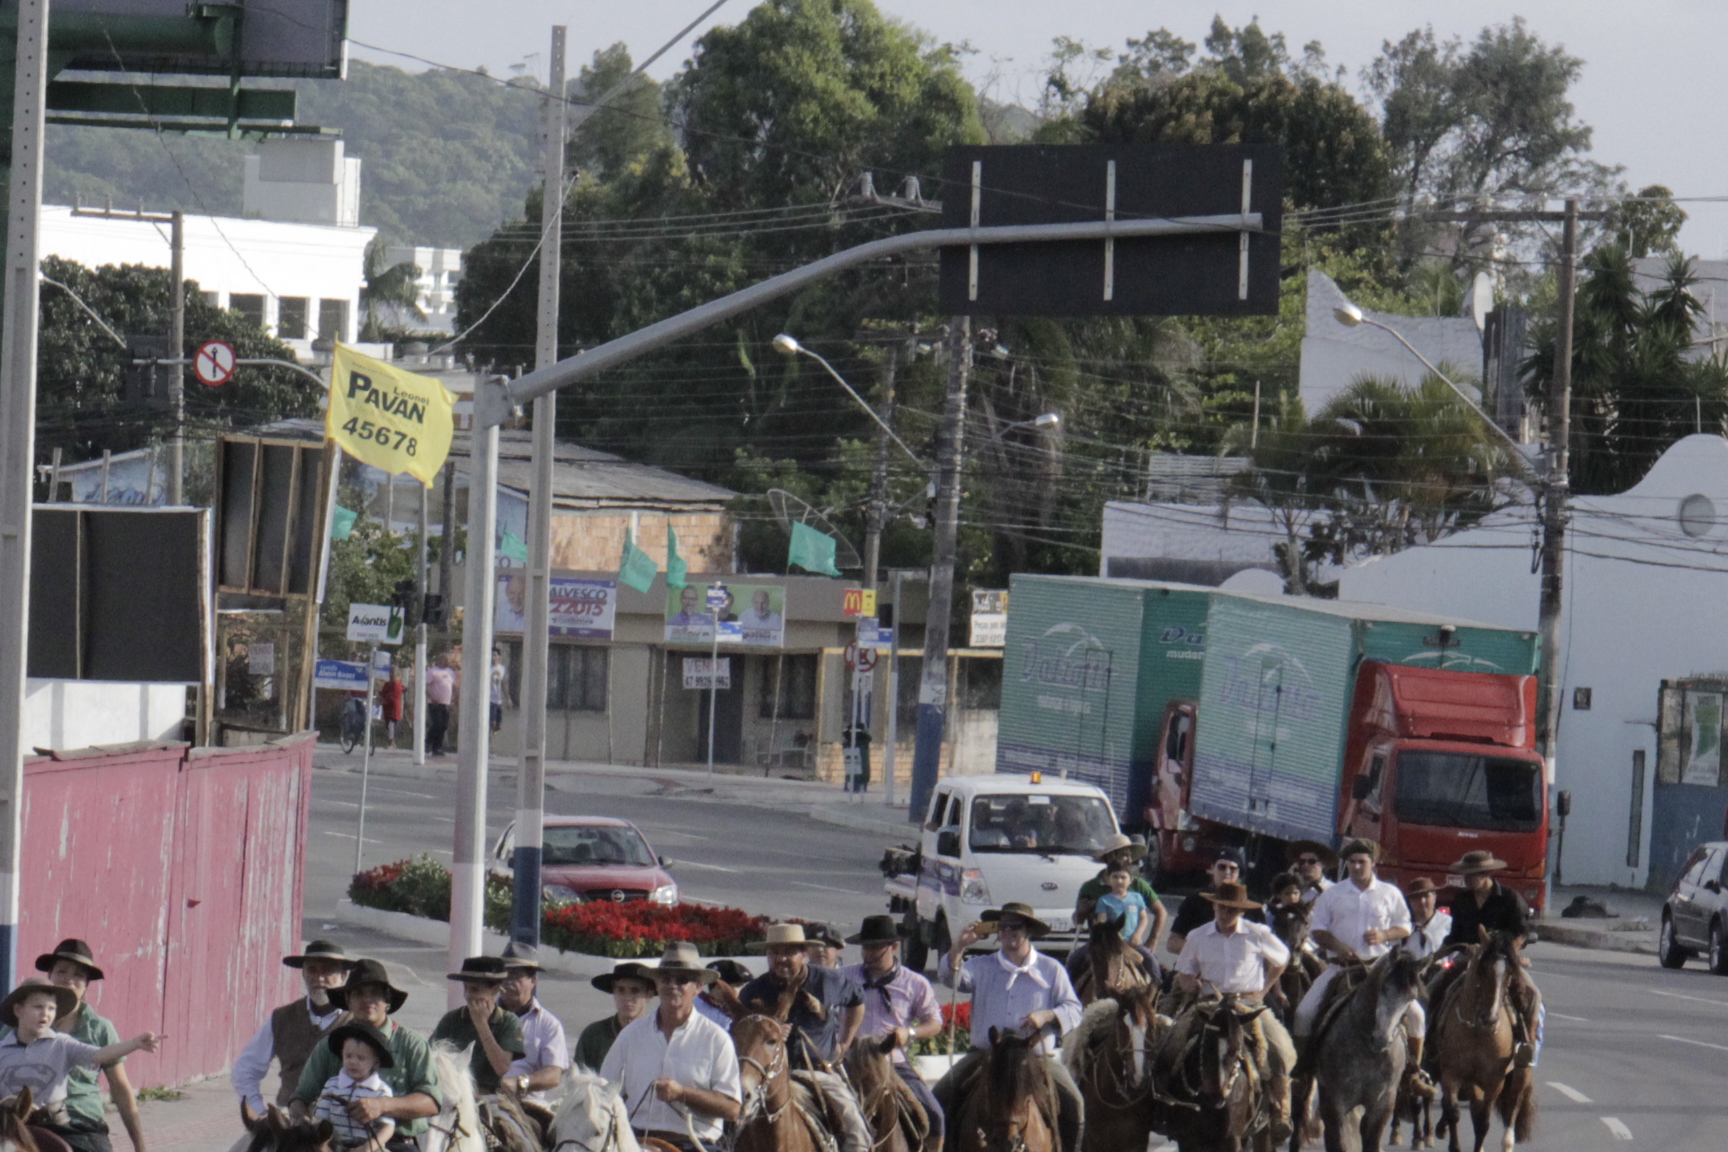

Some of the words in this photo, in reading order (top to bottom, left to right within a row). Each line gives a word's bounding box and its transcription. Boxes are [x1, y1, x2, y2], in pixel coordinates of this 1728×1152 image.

[393, 386, 430, 406] Leonel
[342, 416, 418, 457] 45678
[549, 586, 608, 602] ALVESCO
